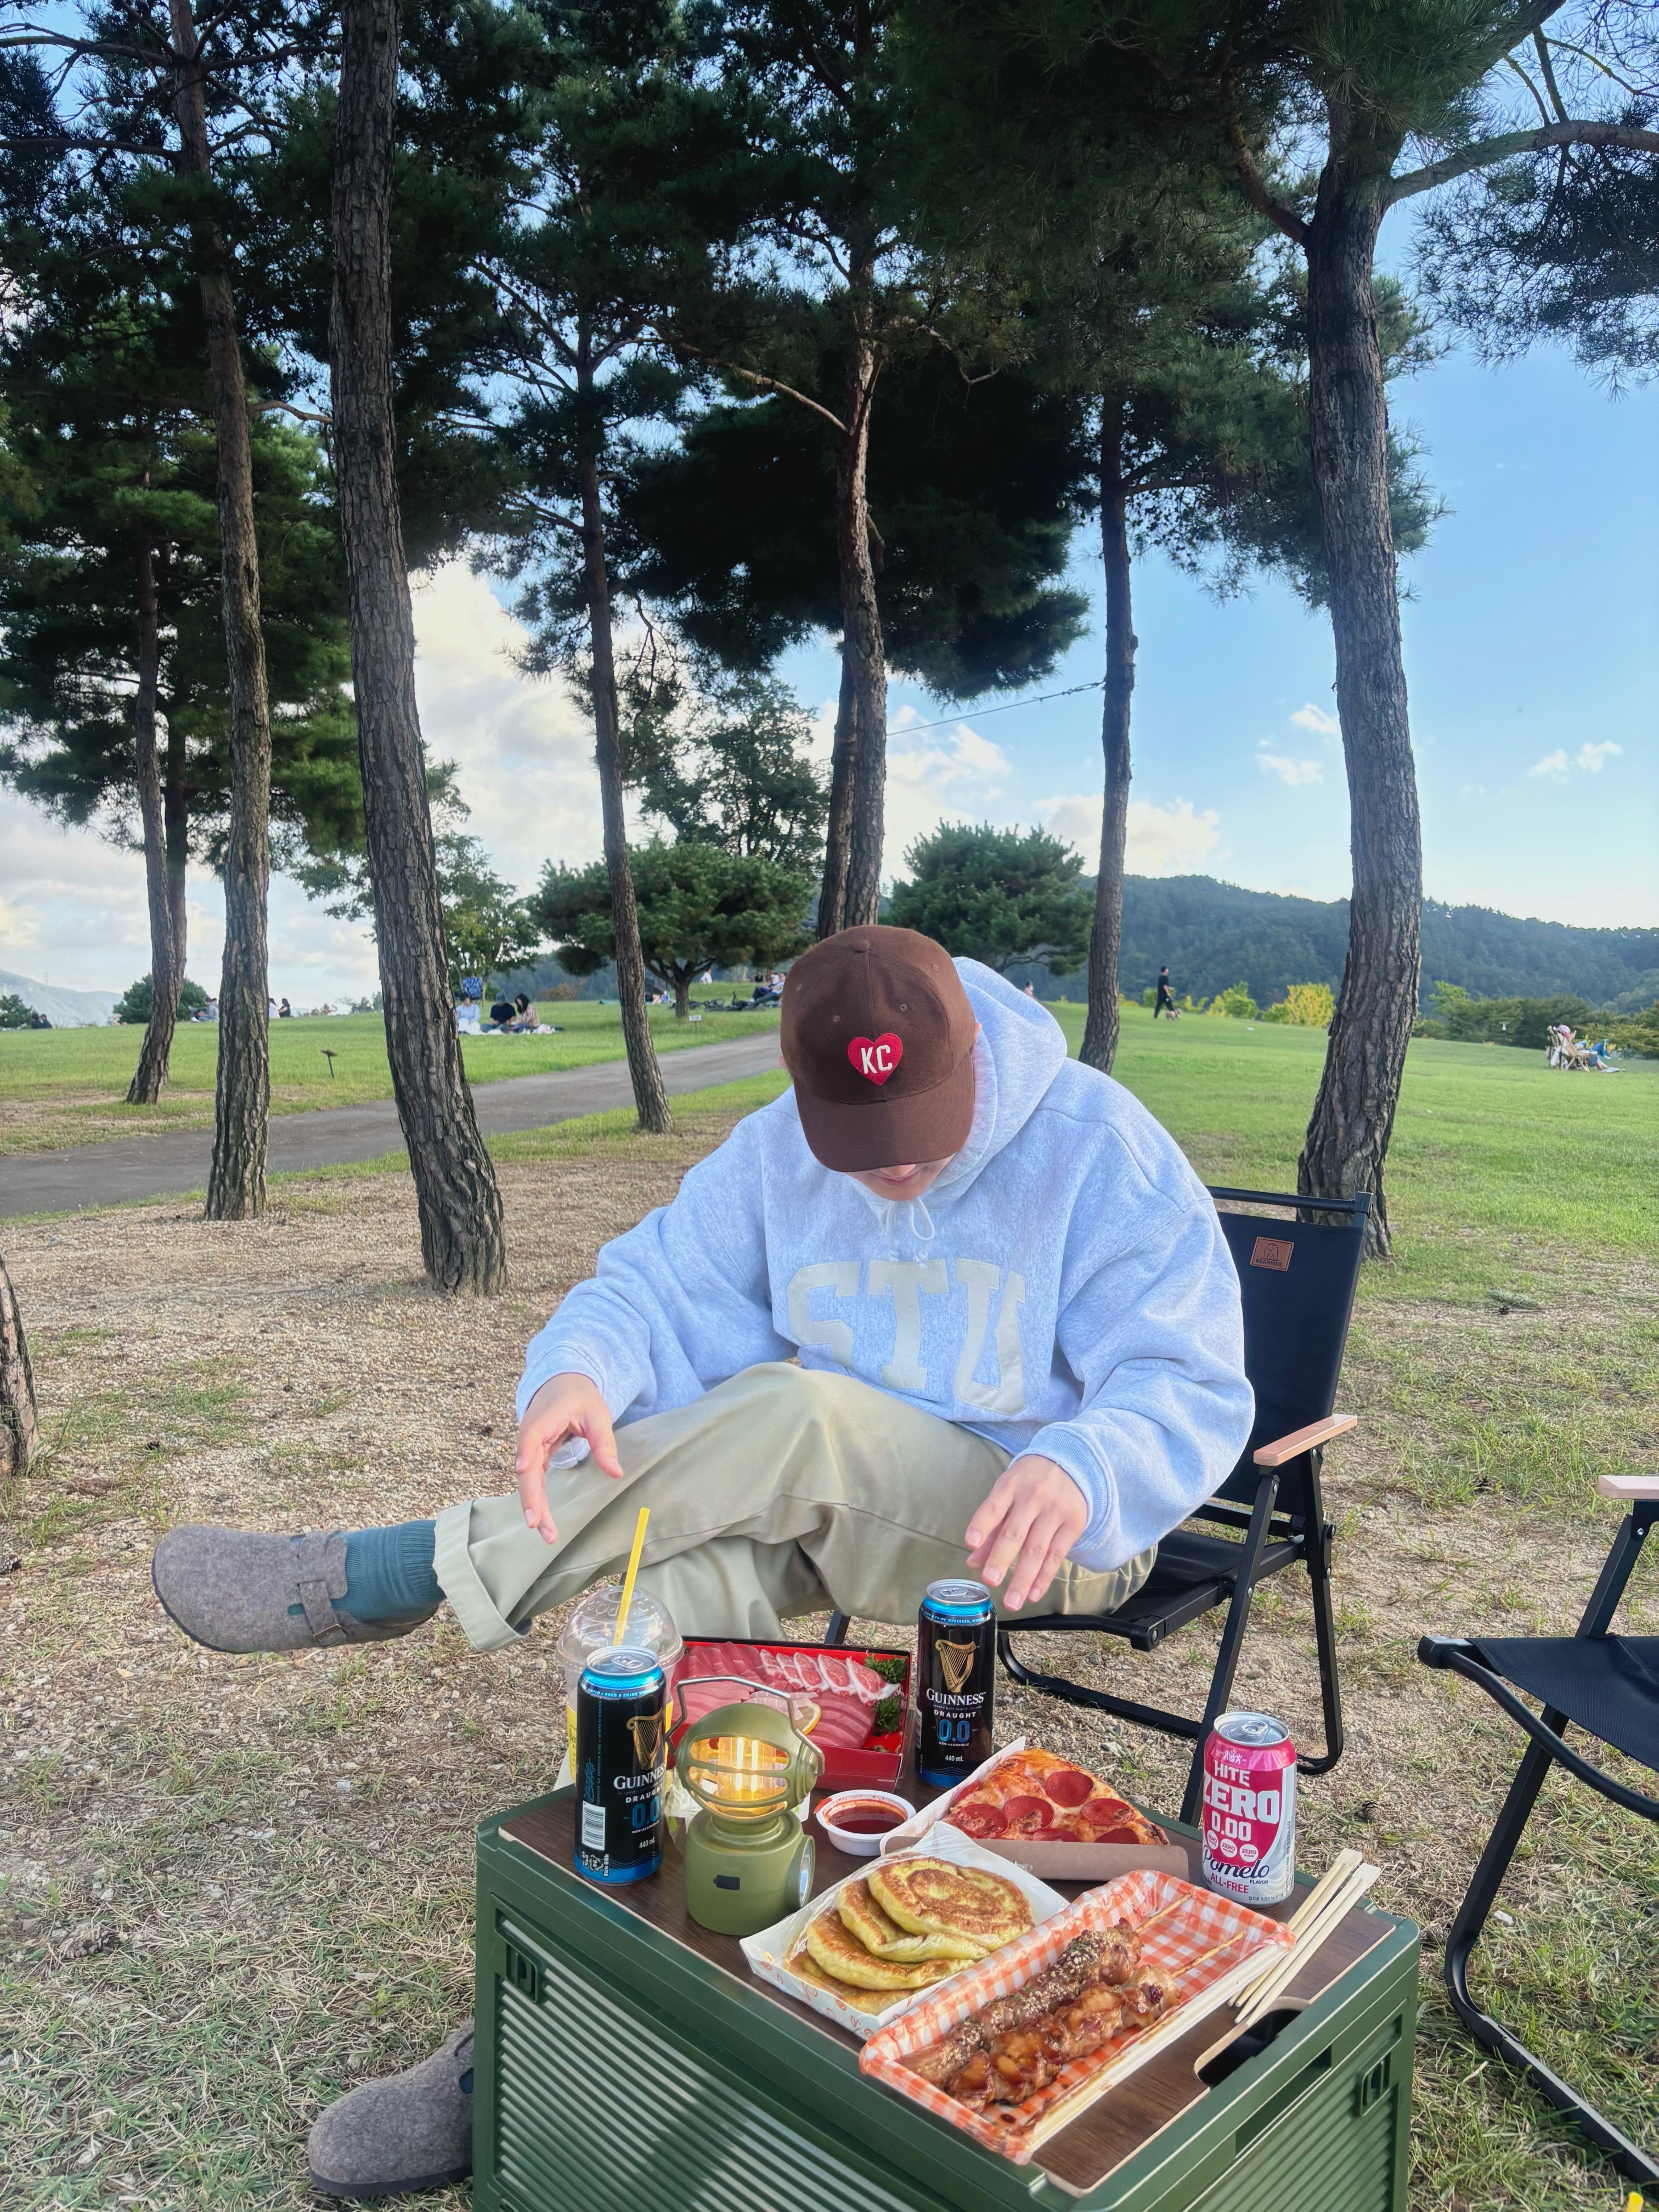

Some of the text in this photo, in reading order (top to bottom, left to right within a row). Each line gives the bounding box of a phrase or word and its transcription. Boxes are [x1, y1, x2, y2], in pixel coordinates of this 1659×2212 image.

[861, 1045, 893, 1074] KC
[926, 1688, 985, 1706] GUINNESS
[934, 1709, 976, 1718] DRAUGHT
[939, 1719, 970, 1742] 0.0
[1214, 1759, 1251, 1788] HITE
[625, 1783, 663, 1803] DRAUGHT
[1204, 1770, 1280, 1824] ZERO
[632, 1796, 660, 1829] 0.0
[1211, 1810, 1251, 1842] 0.00
[639, 1837, 656, 1849] 440 mL
[1208, 1833, 1217, 1843] ZERO
[1222, 1842, 1235, 1851] ZERO
[1203, 1844, 1270, 1878] Pomelo
[1210, 1872, 1249, 1894] ALL-FREE
